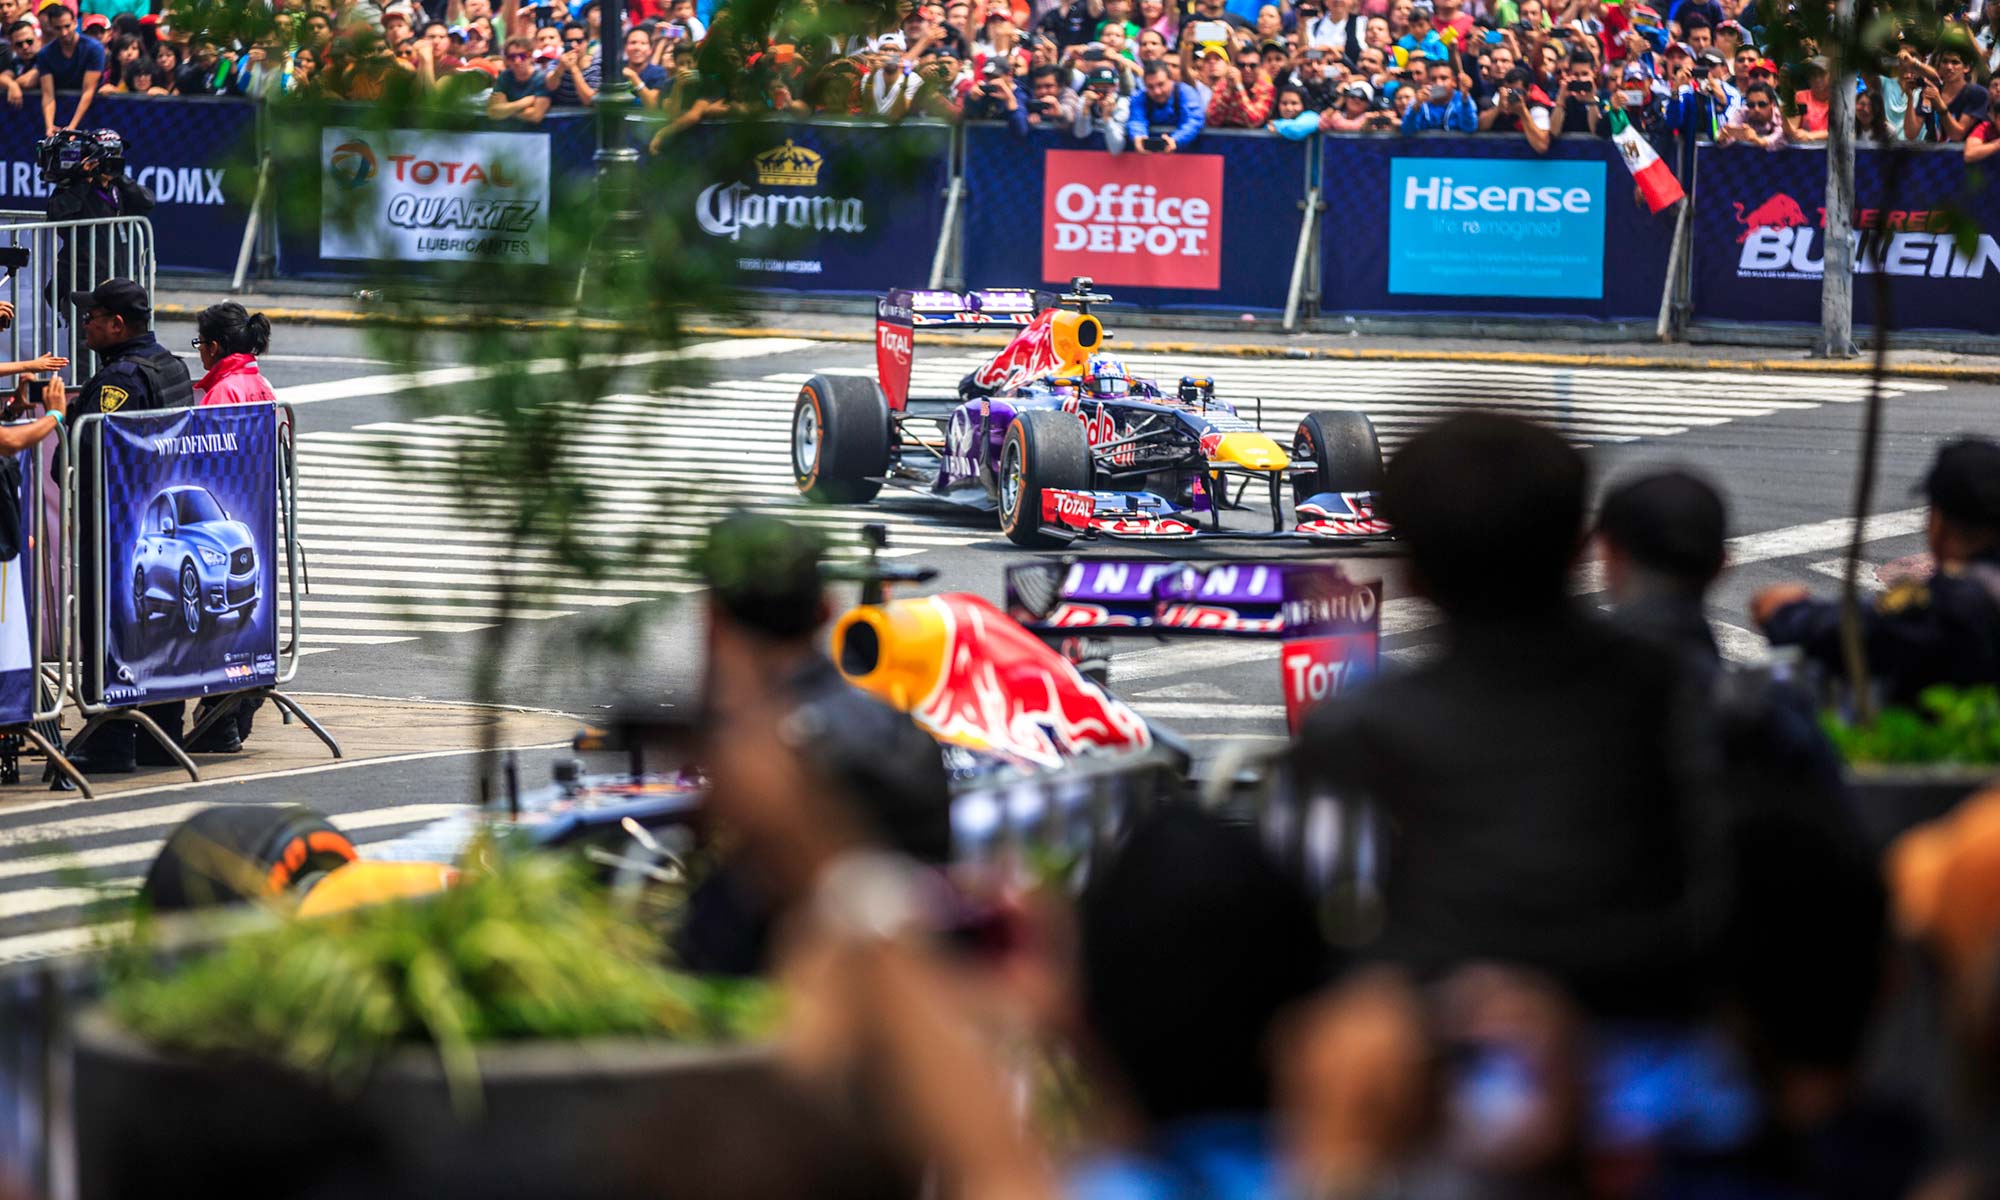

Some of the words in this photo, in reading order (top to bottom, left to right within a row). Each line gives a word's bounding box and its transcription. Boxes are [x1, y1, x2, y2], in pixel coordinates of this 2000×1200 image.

[387, 154, 513, 188] TOTAL
[696, 180, 867, 242] Corona
[1055, 183, 1210, 226] Office
[1404, 176, 1591, 213] Hisense
[387, 192, 540, 233] QUARTZ
[417, 236, 530, 255] LUBRICANTES
[1054, 223, 1207, 256] DEPOT
[878, 326, 911, 355] TOTAL
[1054, 493, 1091, 517] TOTAL
